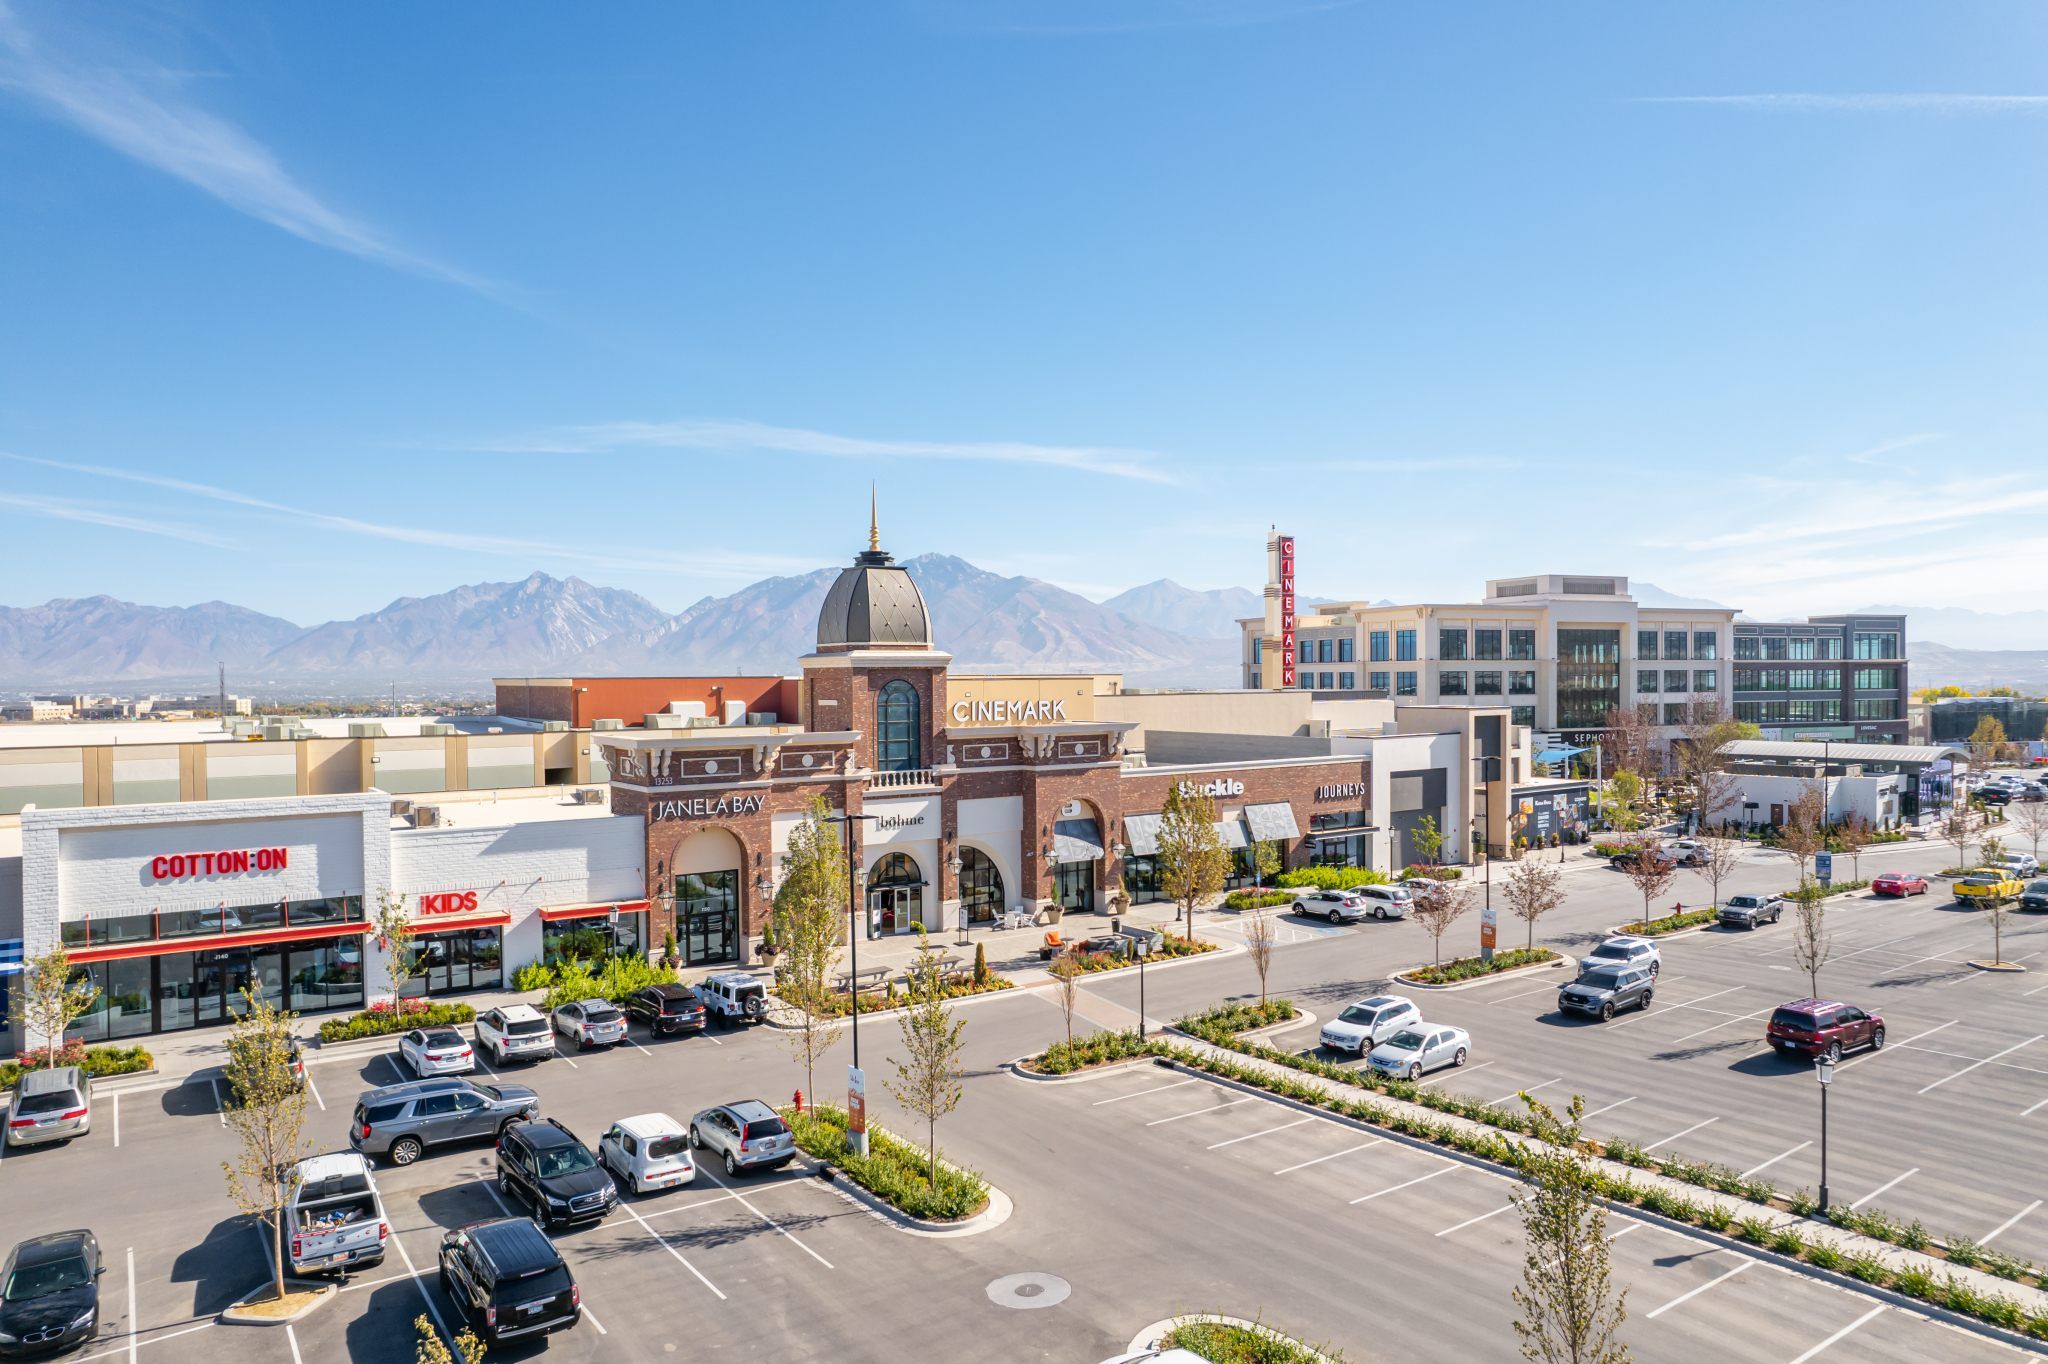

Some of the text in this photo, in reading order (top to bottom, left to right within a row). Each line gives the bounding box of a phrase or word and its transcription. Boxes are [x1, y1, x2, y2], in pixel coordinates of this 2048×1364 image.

[1284, 541, 1293, 683] CINEMARK
[953, 700, 1066, 722] CINEMARK
[655, 777, 673, 785] 13253
[1319, 783, 1365, 799] JOURNEYS
[657, 795, 765, 820] JANELA BAY
[880, 814, 924, 828] böhme
[152, 848, 287, 879] COTTON:ON
[425, 891, 477, 914] KIDS
